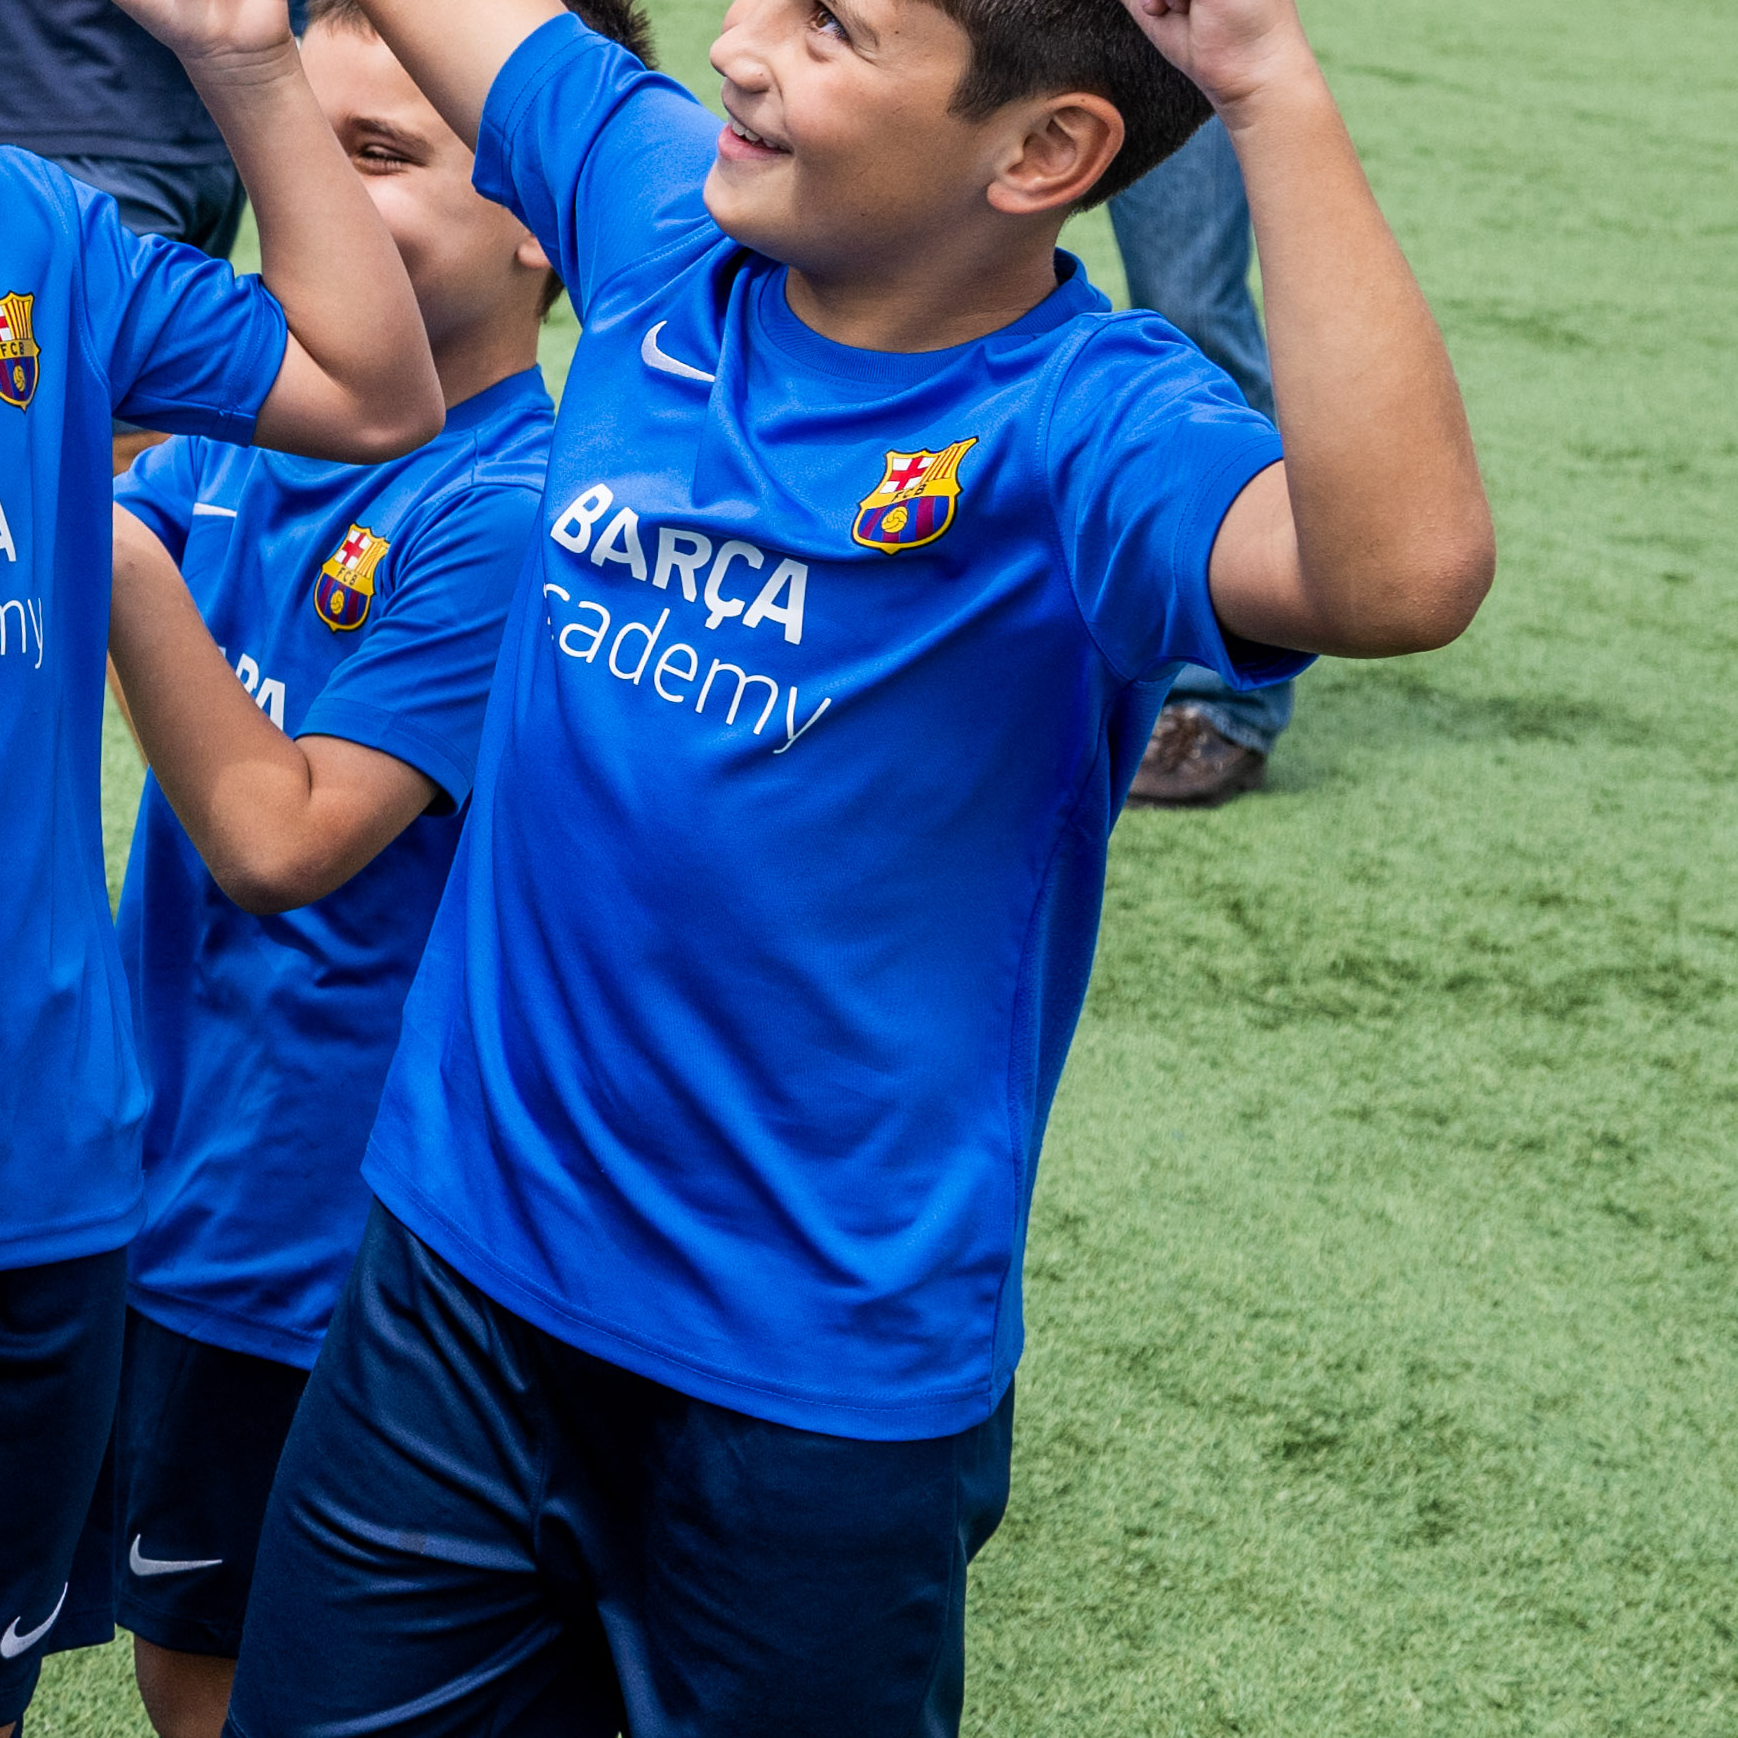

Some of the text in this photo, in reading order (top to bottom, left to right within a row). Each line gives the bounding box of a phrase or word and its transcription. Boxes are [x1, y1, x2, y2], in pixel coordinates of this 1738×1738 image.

[0, 342, 25, 357] FCB
[891, 484, 926, 503] FCB
[550, 483, 809, 645] BARÇA
[336, 567, 358, 586] FCB
